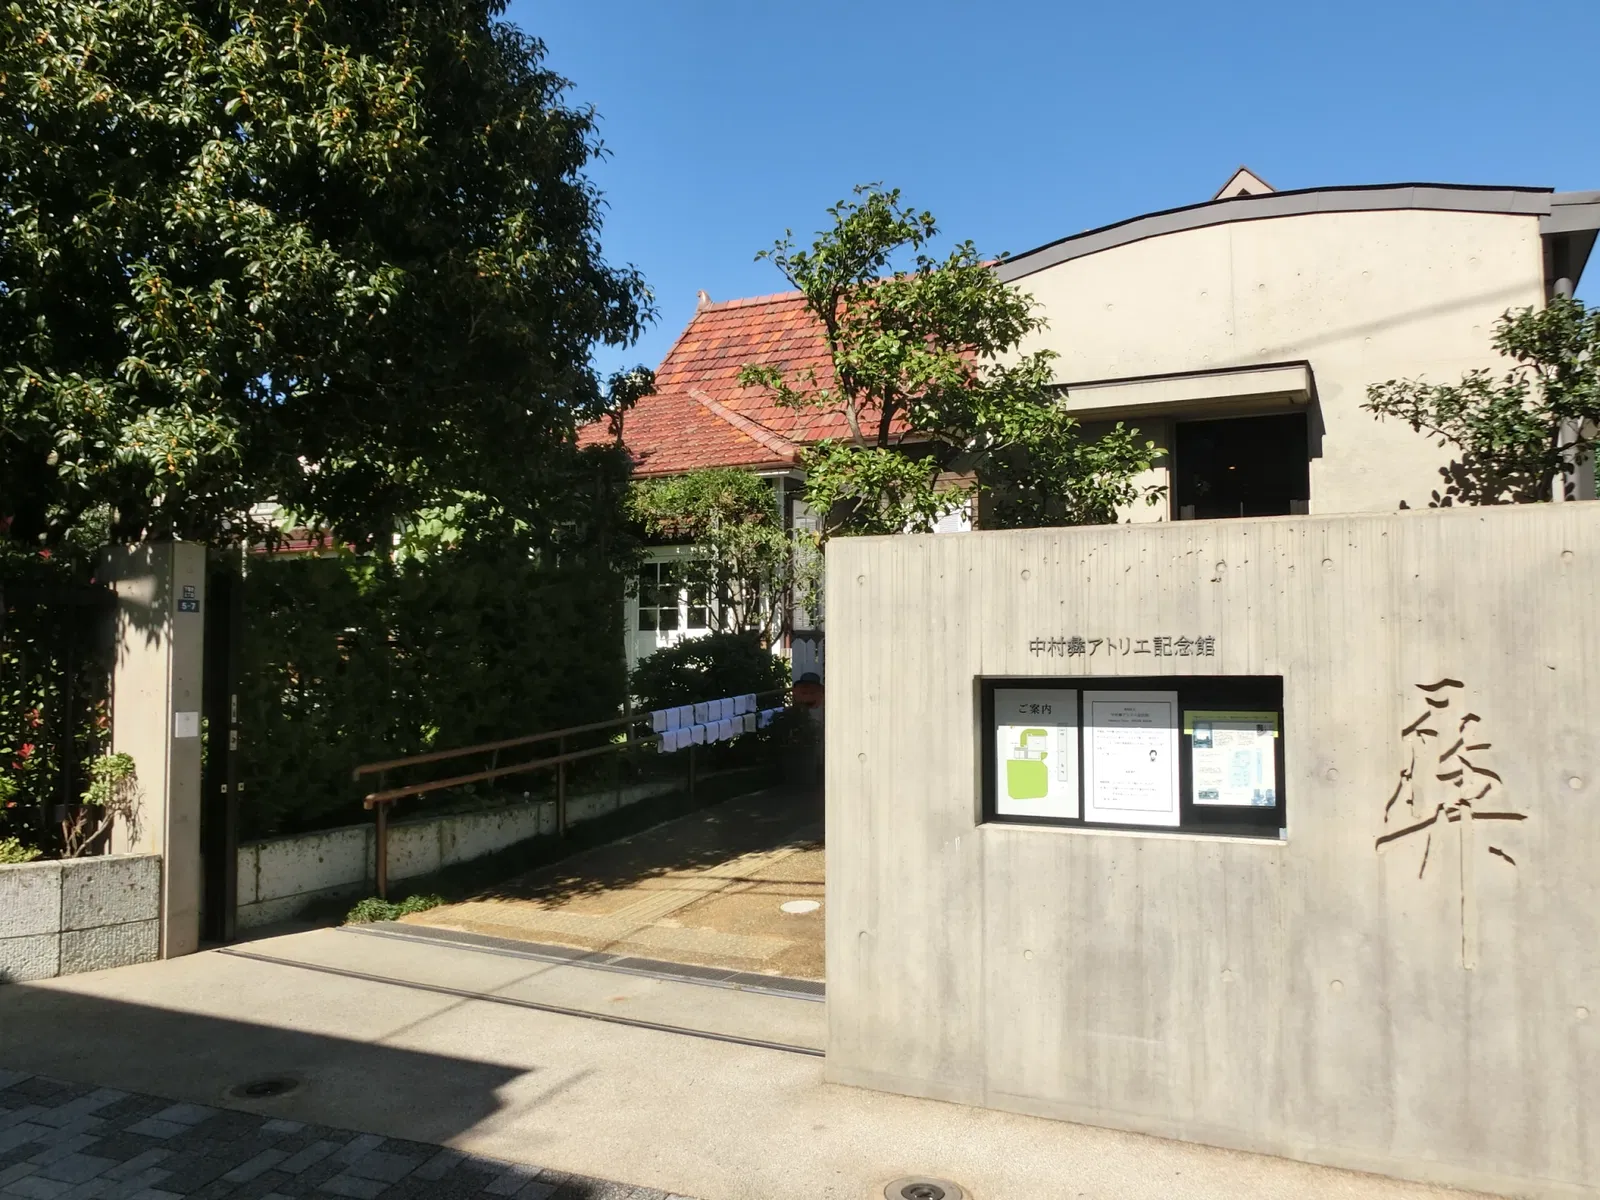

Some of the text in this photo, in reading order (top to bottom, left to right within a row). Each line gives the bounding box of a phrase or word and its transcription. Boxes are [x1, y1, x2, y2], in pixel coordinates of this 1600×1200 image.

[181, 602, 196, 610] 5-7
[1019, 703, 1052, 715] ご案内
